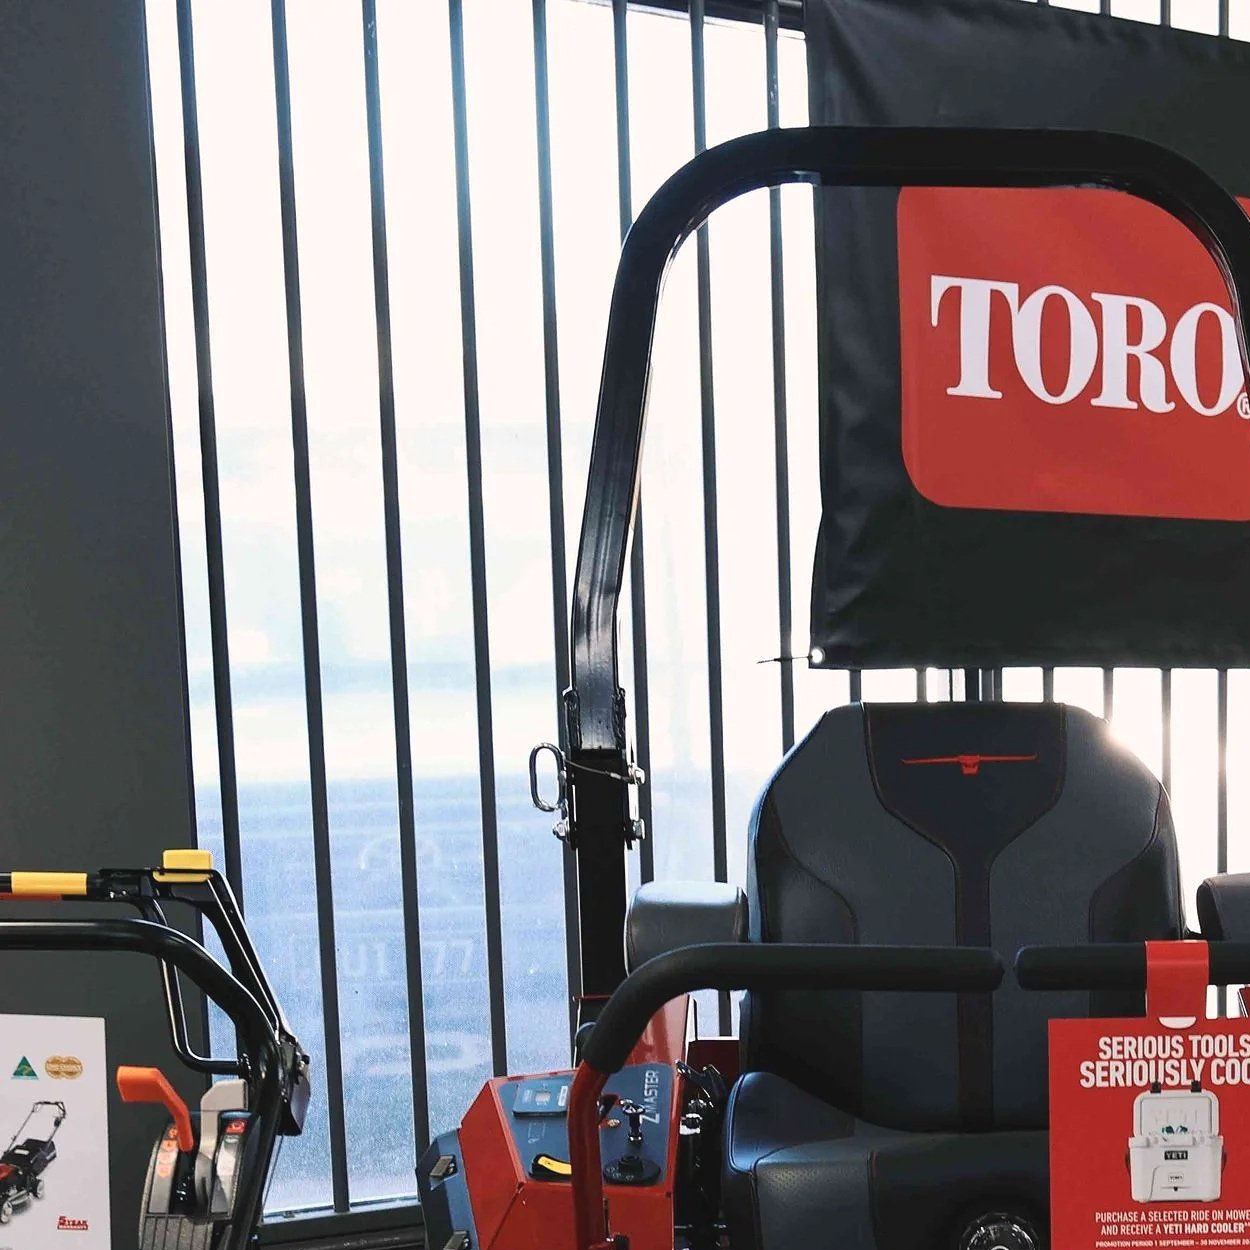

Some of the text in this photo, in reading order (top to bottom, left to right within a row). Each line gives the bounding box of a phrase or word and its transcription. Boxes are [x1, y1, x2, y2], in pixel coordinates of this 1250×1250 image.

[931, 275, 1244, 417] TORO
[1098, 1035, 1184, 1059] SERIOUS
[1079, 1059, 1205, 1088] SERIOUSLY
[643, 1070, 660, 1113] MASTER
[1166, 1151, 1187, 1159] YETI
[1095, 1211, 1138, 1223] PURCHASE
[1140, 1211, 1147, 1222] A
[1148, 1210, 1189, 1222] SELECTED
[1191, 1210, 1210, 1221] RIDE
[1212, 1210, 1224, 1220] ON
[1100, 1224, 1118, 1235] AND
[1120, 1224, 1153, 1235] RECEIVE
[1155, 1224, 1161, 1234] A
[1163, 1223, 1183, 1234] YETI
[1184, 1223, 1209, 1234] HARD
[1095, 1240, 1131, 1248] PROMOTION
